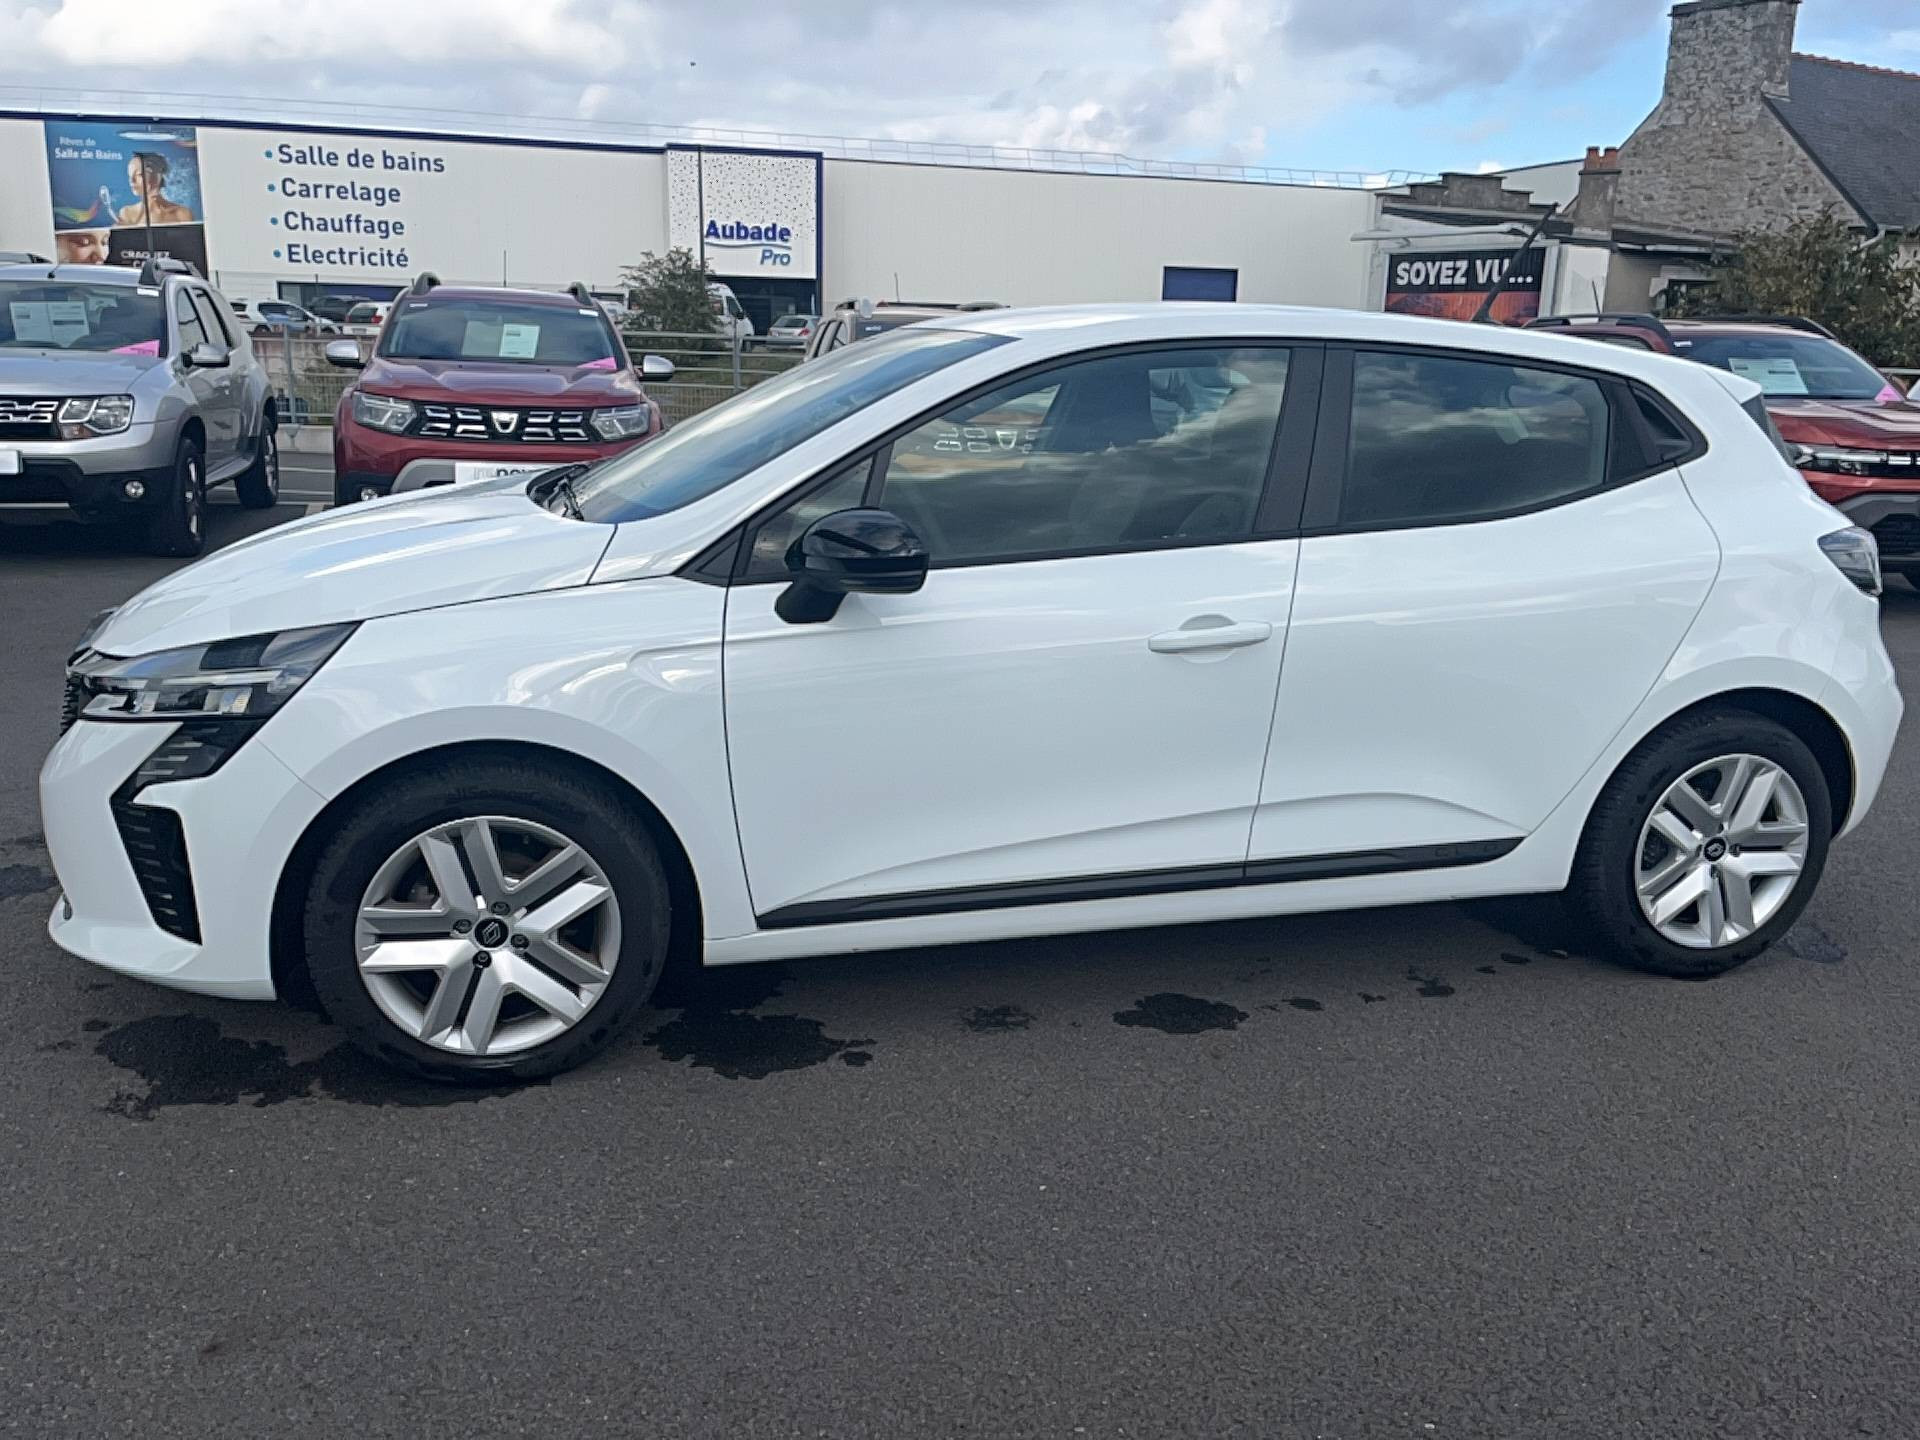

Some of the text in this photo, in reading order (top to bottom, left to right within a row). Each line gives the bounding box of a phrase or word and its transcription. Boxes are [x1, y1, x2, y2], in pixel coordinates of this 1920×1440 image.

[55, 147, 123, 160] Salle de Bains
[278, 143, 446, 173] Salle de bains
[281, 177, 401, 207] Carrelage
[284, 210, 405, 240] Chauffage
[705, 219, 791, 242] Aubade
[287, 243, 409, 268] Electricité
[759, 249, 791, 266] Pro
[1396, 259, 1470, 286] SOYEZ
